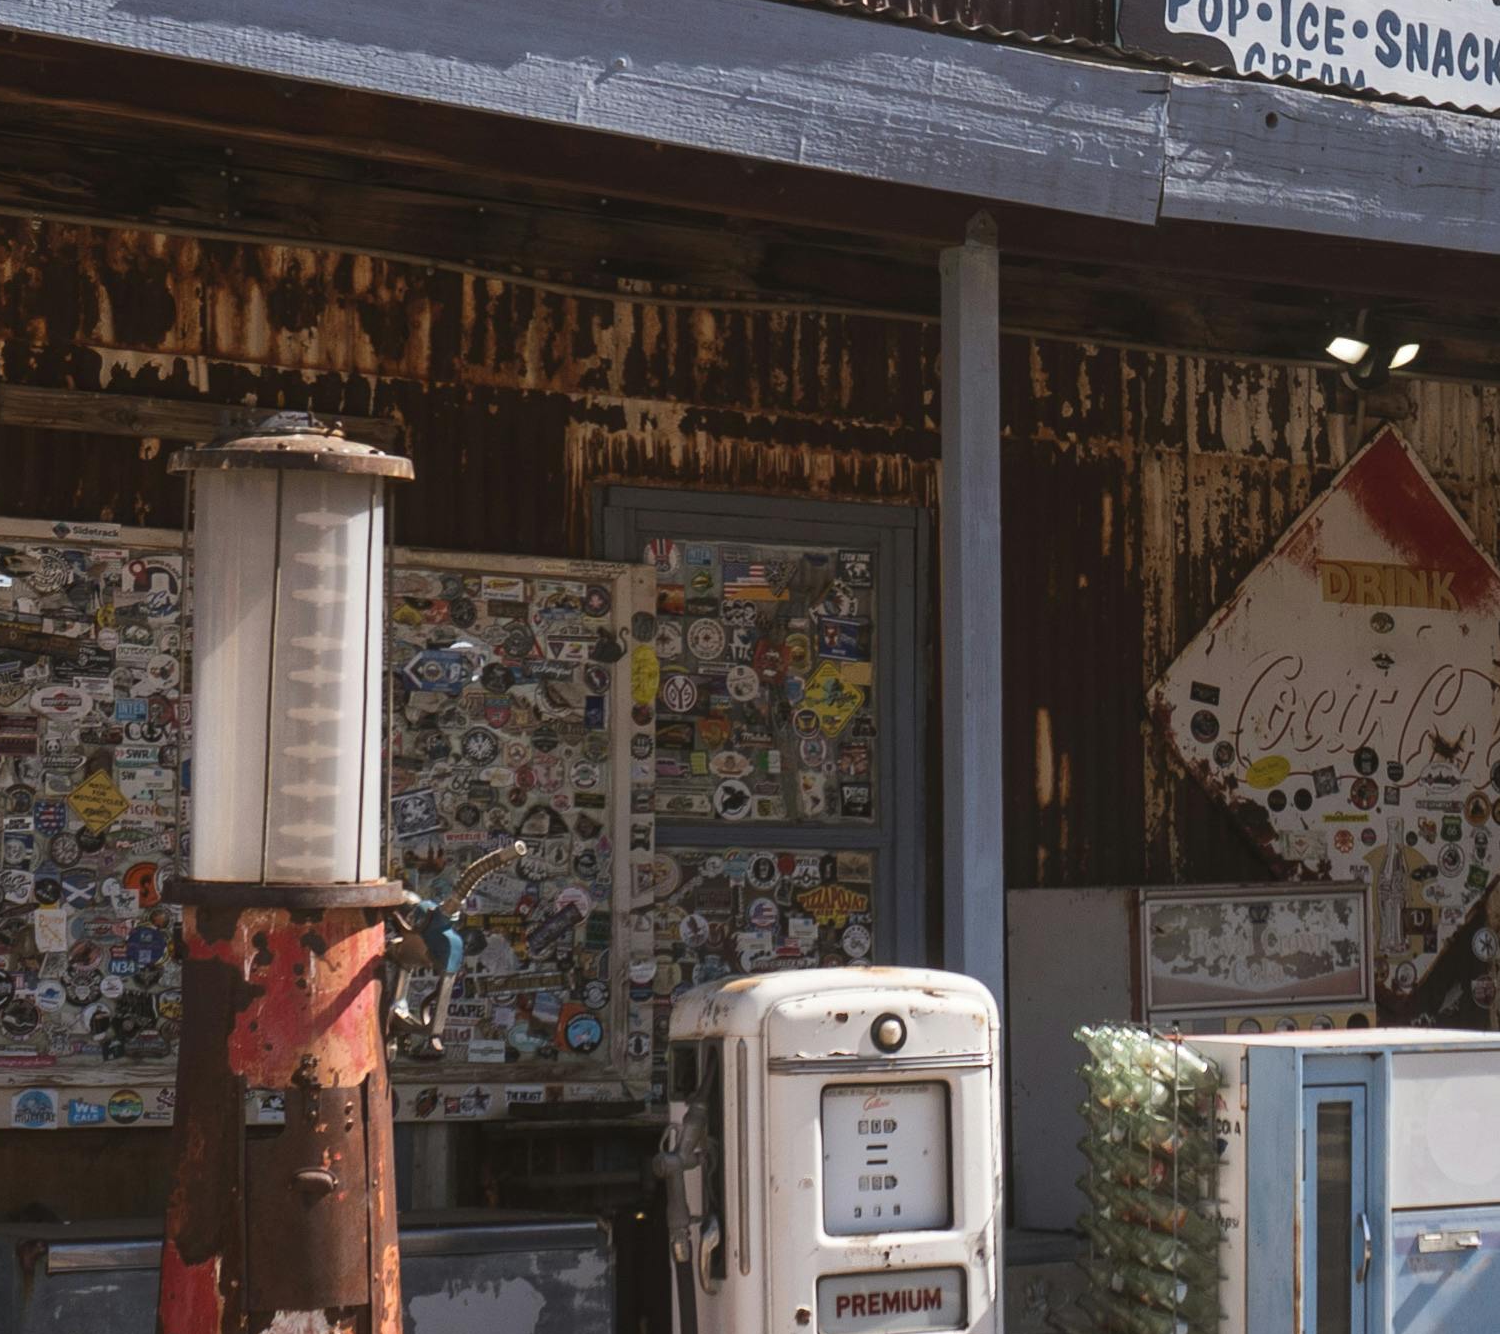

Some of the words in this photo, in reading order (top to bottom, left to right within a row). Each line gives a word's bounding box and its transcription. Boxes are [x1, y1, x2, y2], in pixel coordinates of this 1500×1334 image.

[72, 525, 121, 538] Sidetrack
[1322, 562, 1458, 610] DRINK
[835, 1286, 943, 1320] PREMIUM
